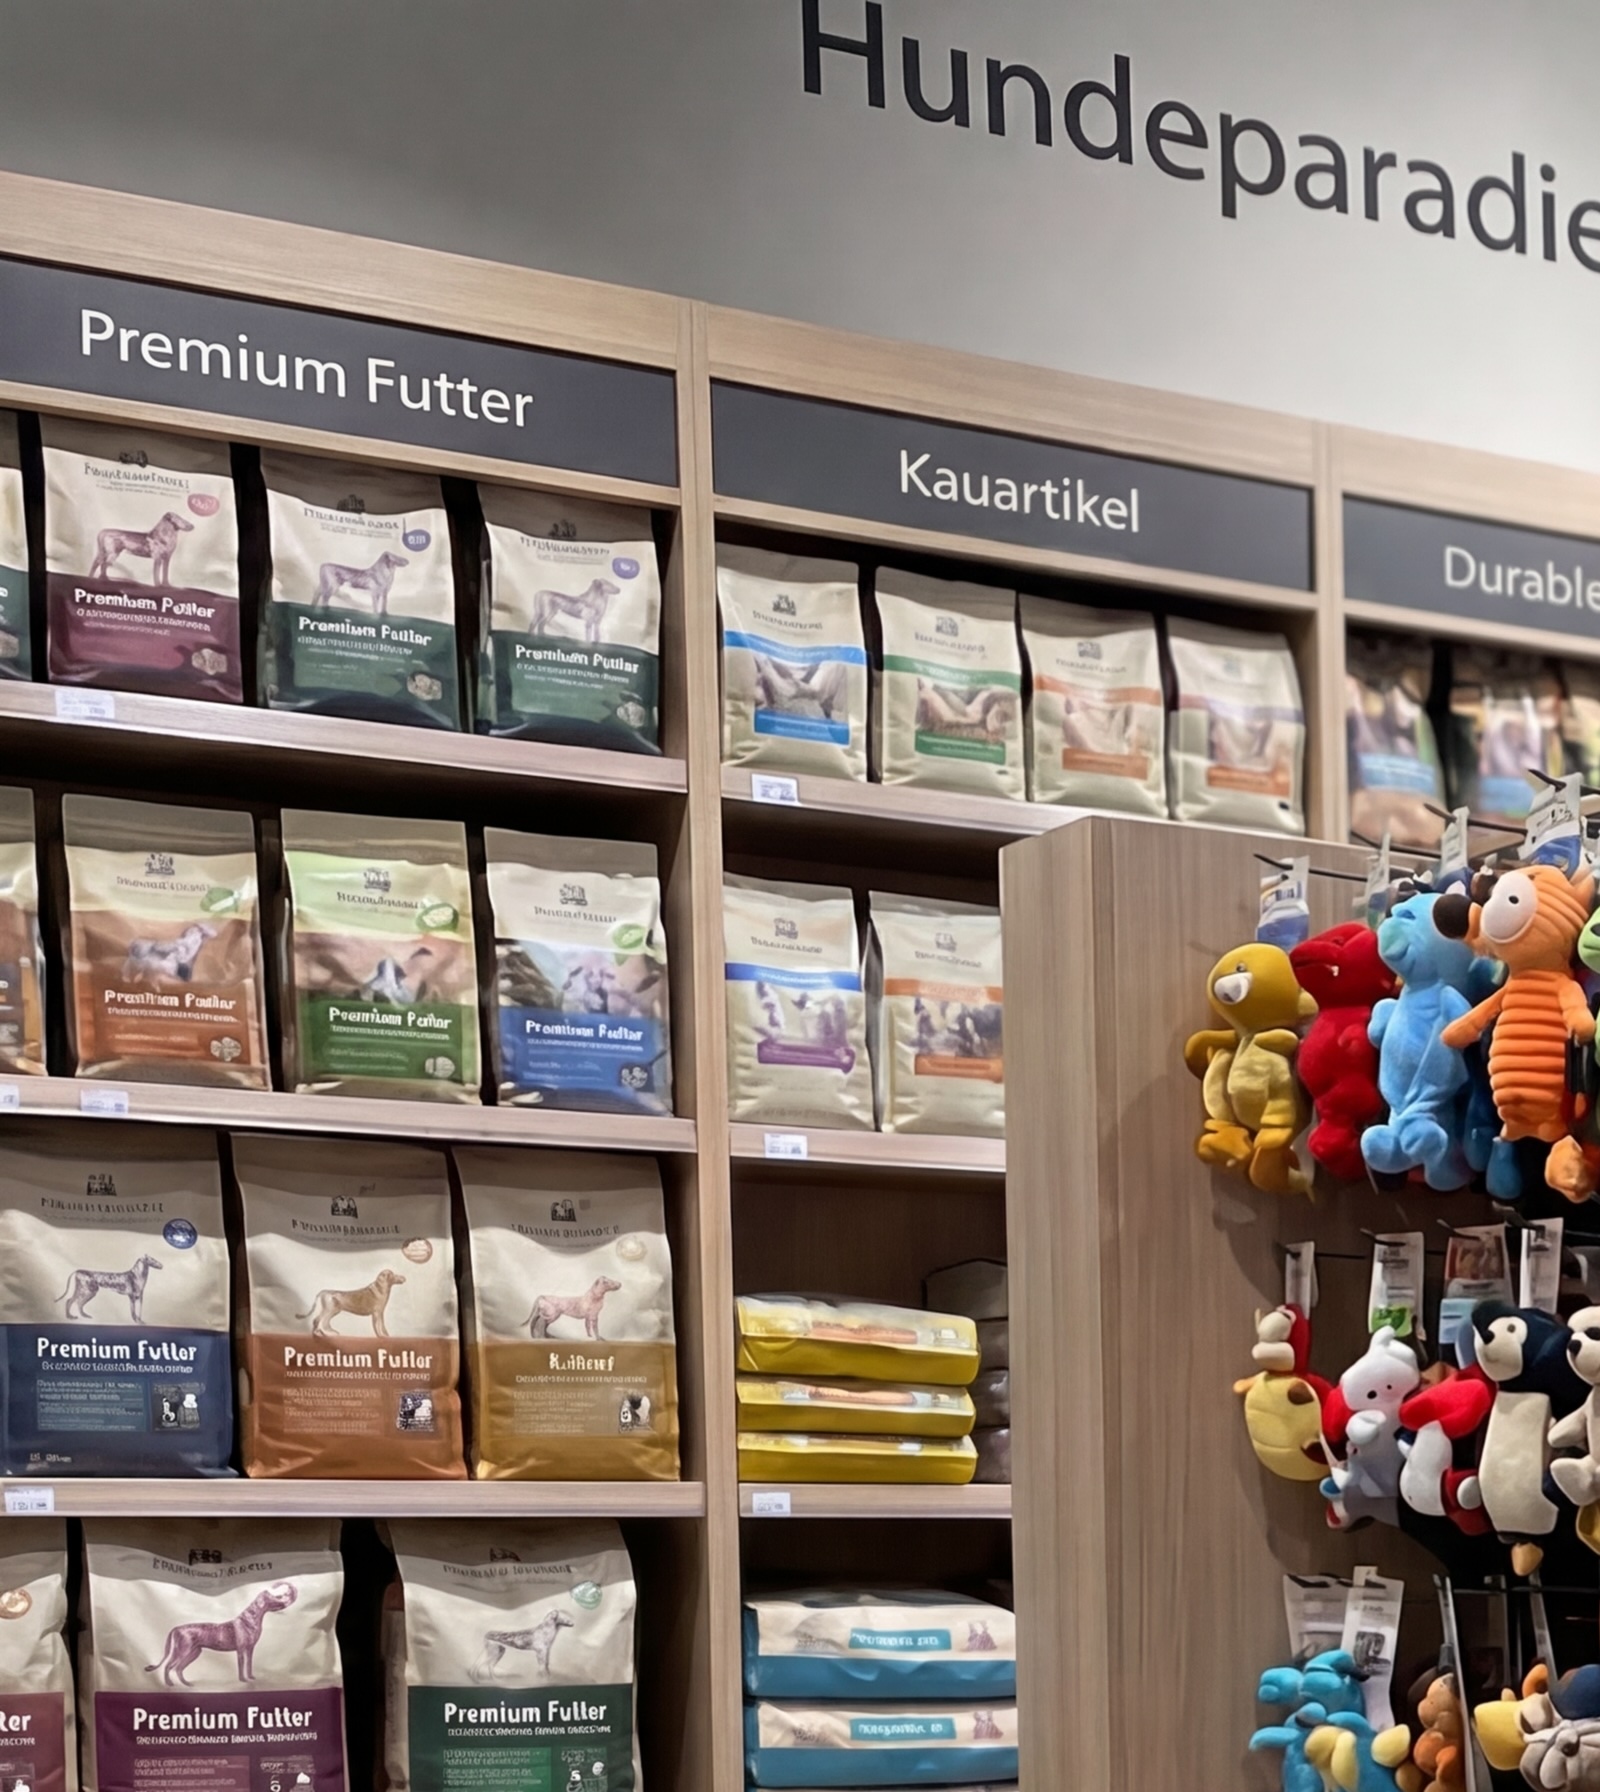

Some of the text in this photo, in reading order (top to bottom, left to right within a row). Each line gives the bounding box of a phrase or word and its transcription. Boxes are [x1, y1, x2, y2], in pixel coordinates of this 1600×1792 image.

[80, 308, 533, 427] Premium Futter
[900, 450, 1140, 533] Kauartikel
[37, 1337, 131, 1359] Premium
[284, 1346, 372, 1368] Premium
[133, 1707, 239, 1730] Premium
[444, 1701, 541, 1724] Premium
